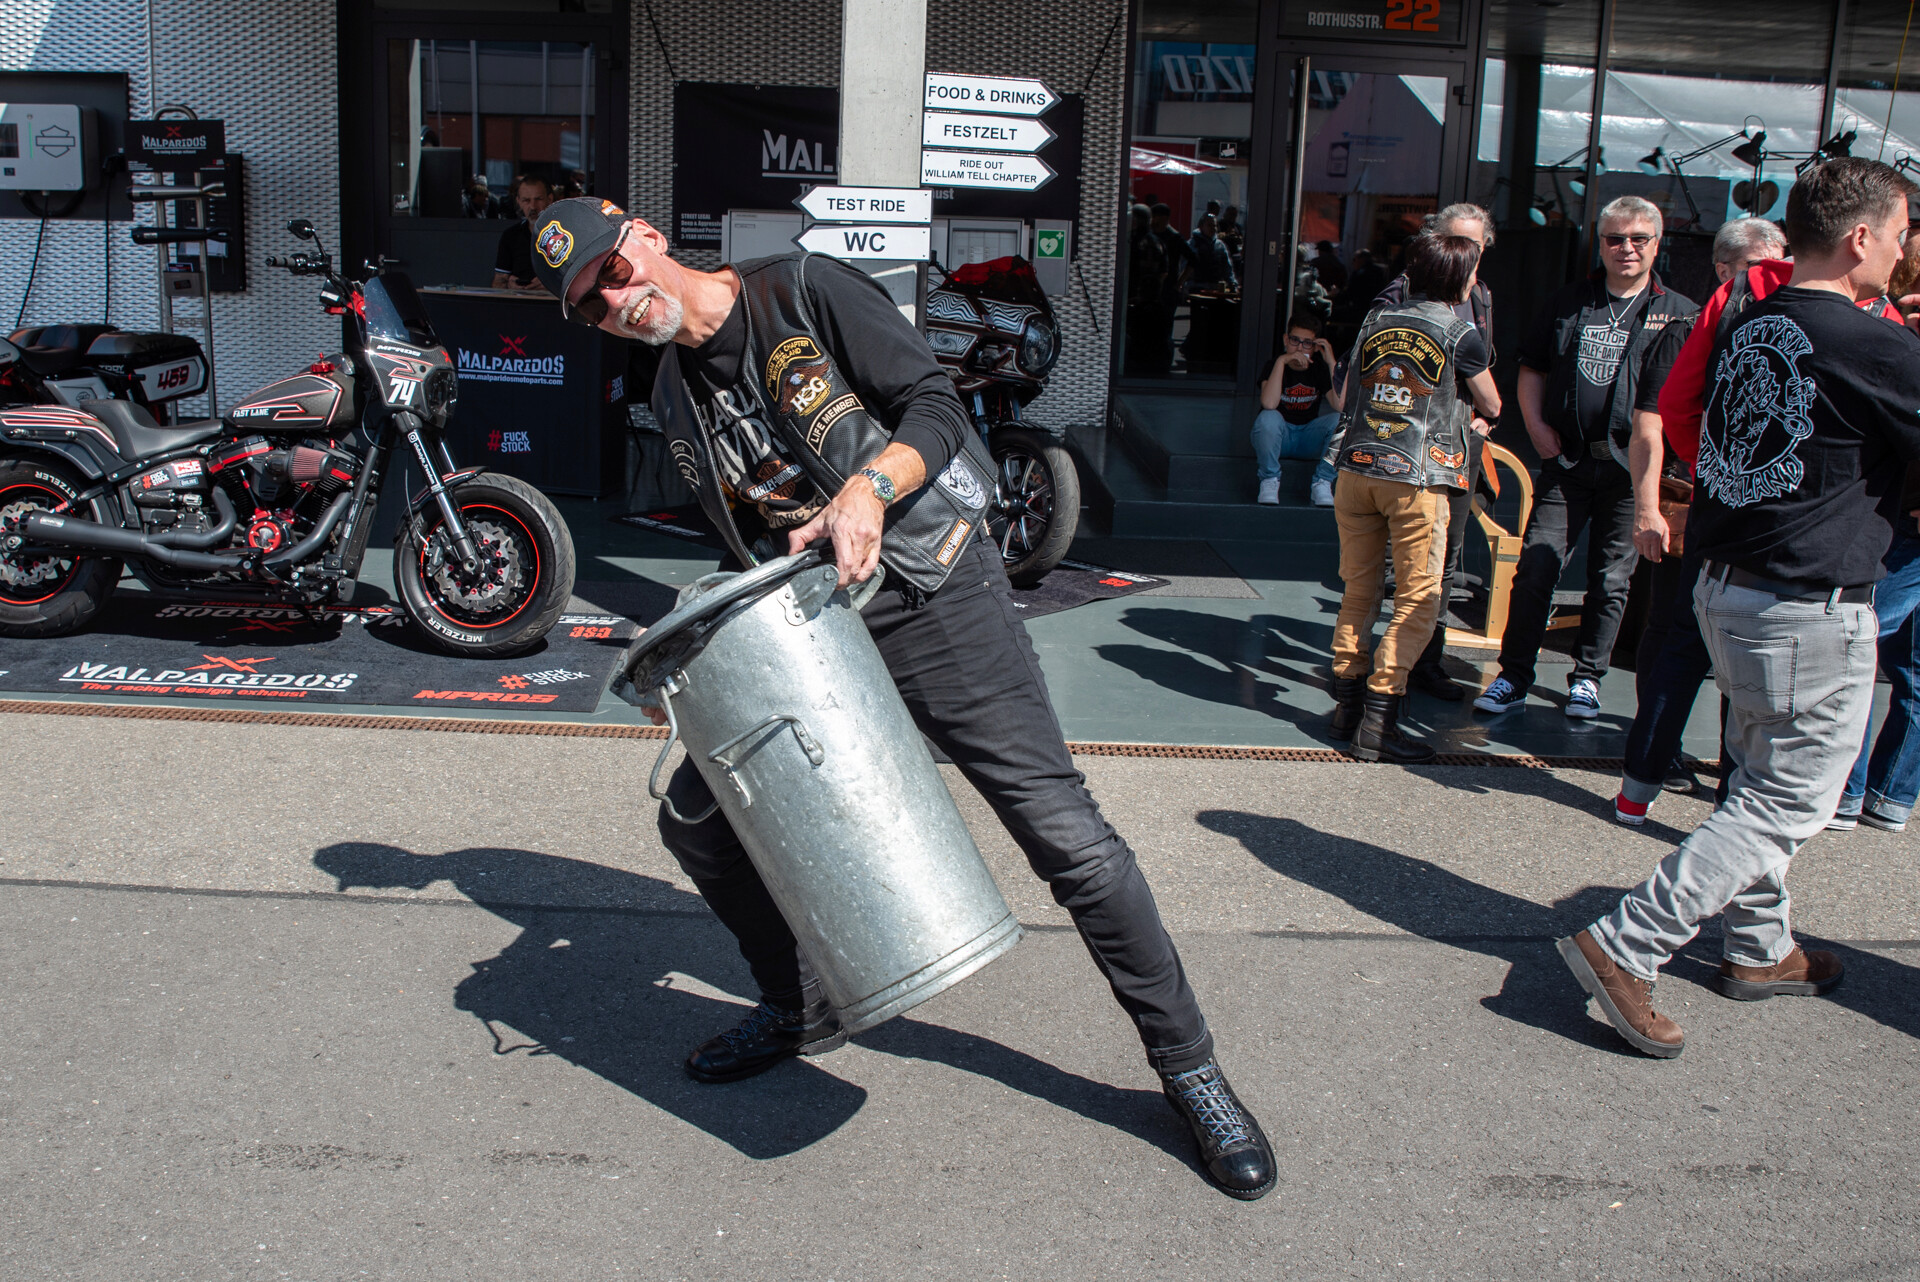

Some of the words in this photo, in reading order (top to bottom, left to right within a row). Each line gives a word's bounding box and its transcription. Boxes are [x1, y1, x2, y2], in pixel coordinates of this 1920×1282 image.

[1308, 12, 1383, 29] ROTHUSSTR.
[1385, 0, 1441, 32] 22
[928, 85, 970, 100] FOOD
[975, 88, 985, 101] &
[990, 90, 1046, 105] DRINKS
[944, 124, 1018, 141] FESTZELT
[142, 135, 206, 148] MALPARIDOS
[762, 129, 839, 173] MAL
[959, 159, 982, 169] RIDE
[984, 160, 1004, 170] OUT
[925, 168, 965, 179] WILLIAM
[967, 171, 990, 181] TELL
[992, 172, 1037, 183] CHAPTER
[930, 187, 955, 200] ust
[827, 198, 865, 211] TEST
[870, 199, 906, 212] RIDE
[844, 231, 886, 252] WC
[1591, 330, 1626, 344] MOTOR
[377, 345, 421, 356] MPRDS
[783, 339, 809, 352] CHAPTER
[1363, 332, 1395, 353] WILLIAM
[1397, 331, 1413, 342] TELL
[1415, 336, 1444, 365] CHAPTER
[1377, 341, 1426, 362] SWITZERLAND
[457, 348, 564, 374] MALPARIDOS
[457, 373, 564, 386] www.malparidosmotoparts.com
[388, 377, 417, 405] 74
[233, 408, 249, 418] FAST
[250, 408, 269, 417] LANE
[811, 421, 826, 443] LIFE
[822, 397, 856, 424] MEMBER
[503, 431, 529, 443] FUCK
[500, 440, 531, 452] STOCK
[35, 471, 77, 500] ETZELER
[427, 616, 483, 643] METZELER
[63, 661, 358, 690] MALPARIDOS
[522, 668, 572, 680] FUCK
[532, 672, 591, 686] STOCK
[81, 682, 112, 691] The
[115, 684, 170, 694] racing
[175, 686, 233, 697] design
[238, 687, 307, 698] exhaust
[413, 689, 559, 703] MPRDS
